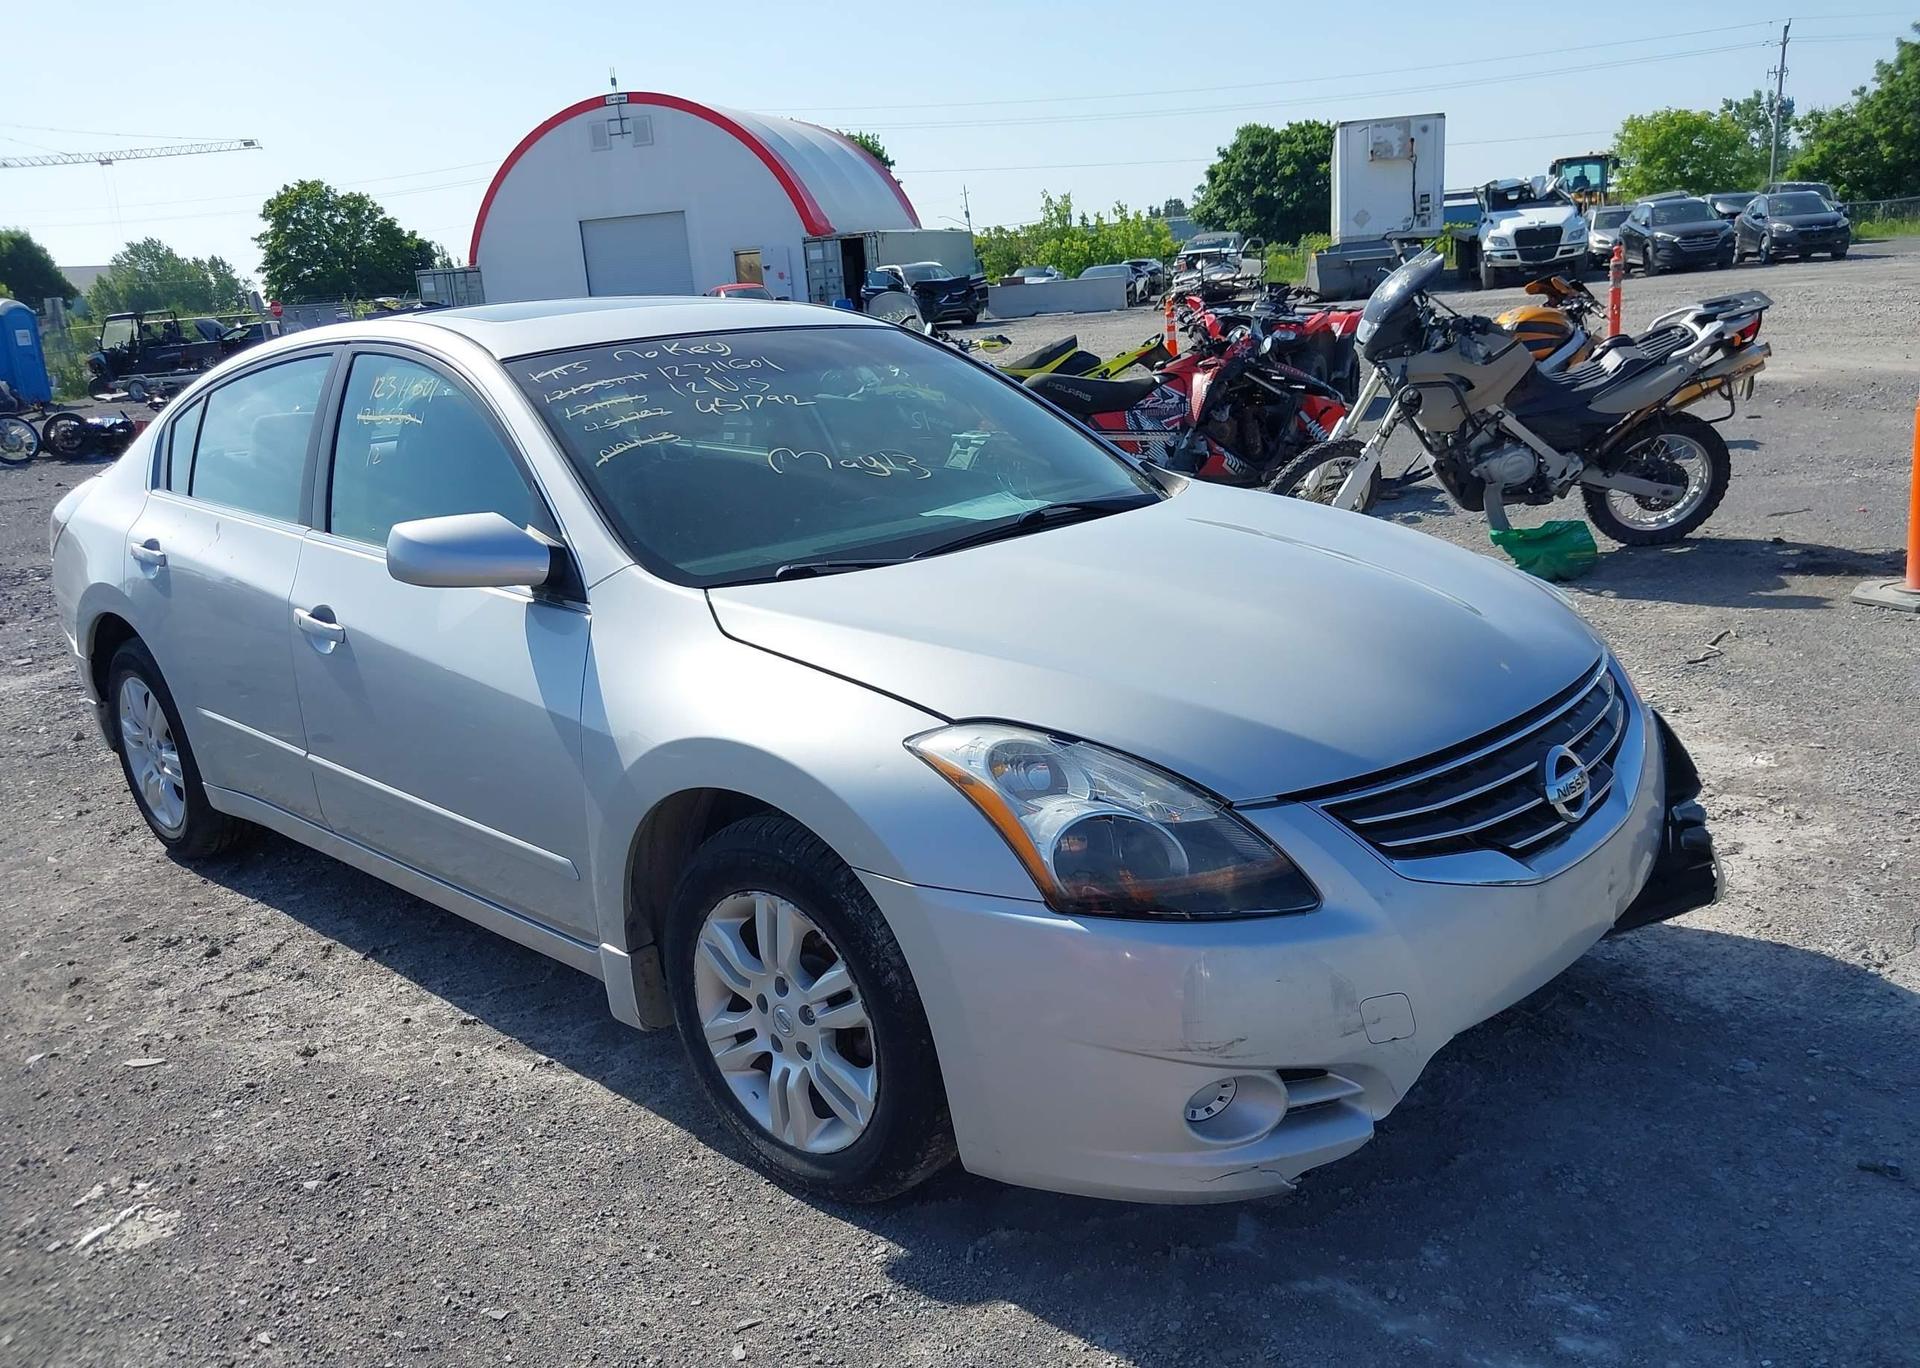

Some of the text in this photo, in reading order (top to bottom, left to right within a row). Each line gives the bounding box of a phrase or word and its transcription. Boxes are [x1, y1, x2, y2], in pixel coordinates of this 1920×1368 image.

[657, 356, 786, 381] 12311601
[1046, 381, 1093, 402] POLARIS
[695, 393, 817, 416] 451792
[1556, 775, 1588, 798] NISS
